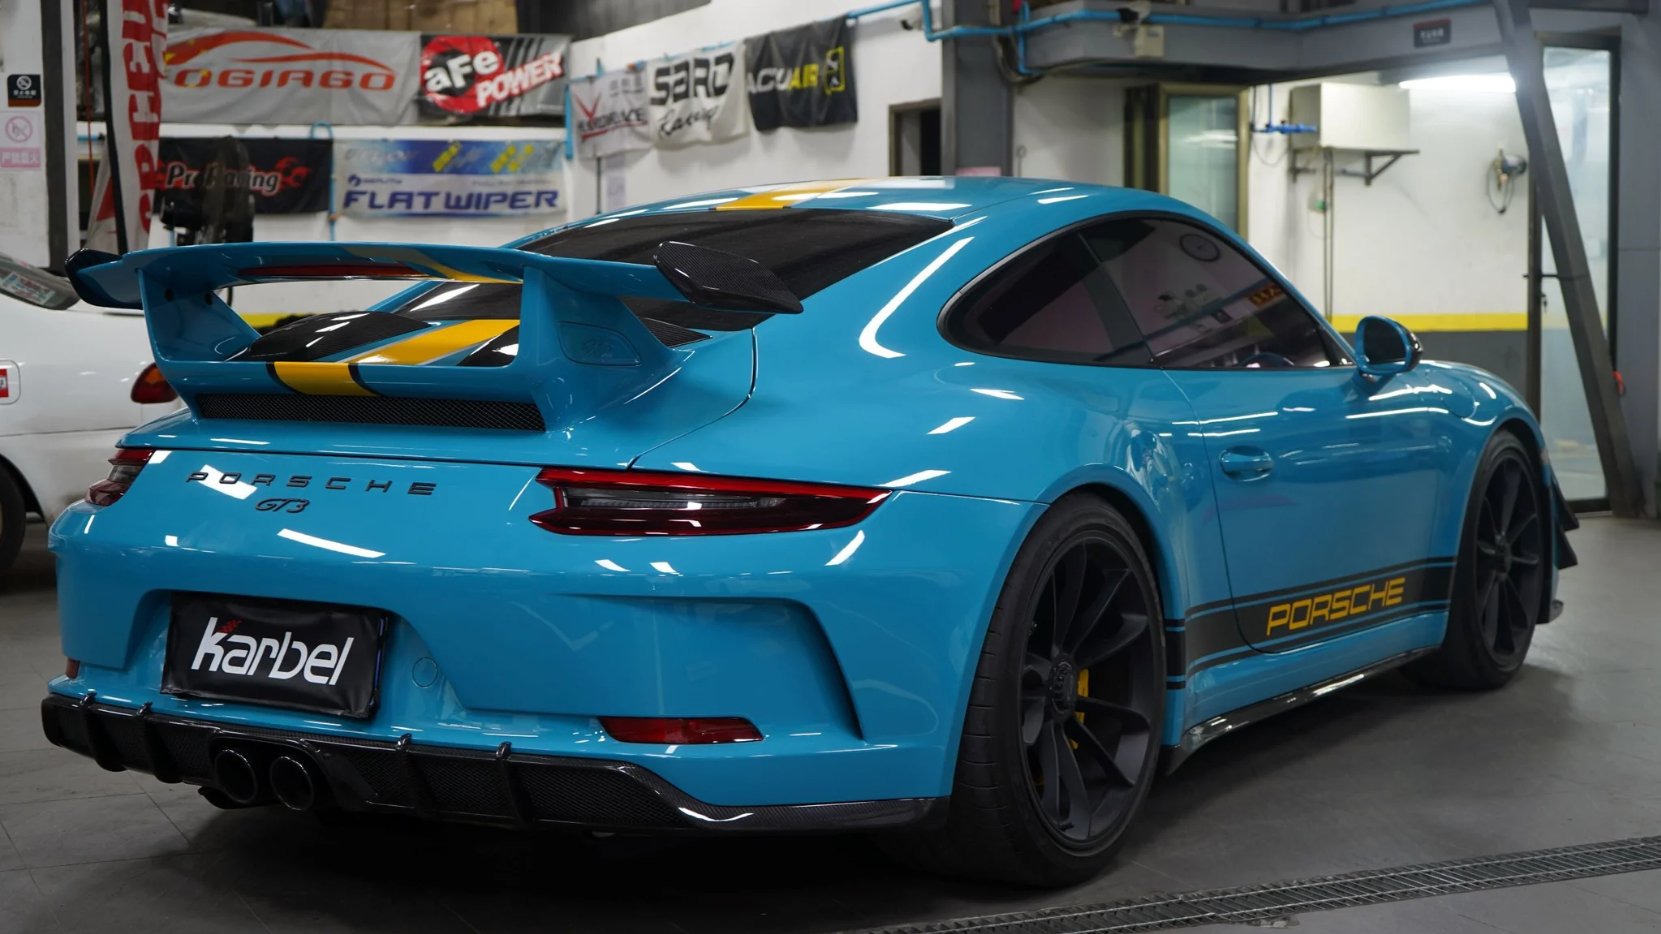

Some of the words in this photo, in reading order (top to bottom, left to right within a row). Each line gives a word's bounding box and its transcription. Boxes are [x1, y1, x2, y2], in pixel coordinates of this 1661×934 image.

[424, 50, 499, 92] aFe
[475, 50, 564, 108] POWER
[186, 471, 437, 496] PORSCHE
[255, 498, 311, 514] GT3
[1266, 577, 1406, 637] PORSCHE
[190, 616, 355, 686] karbel
